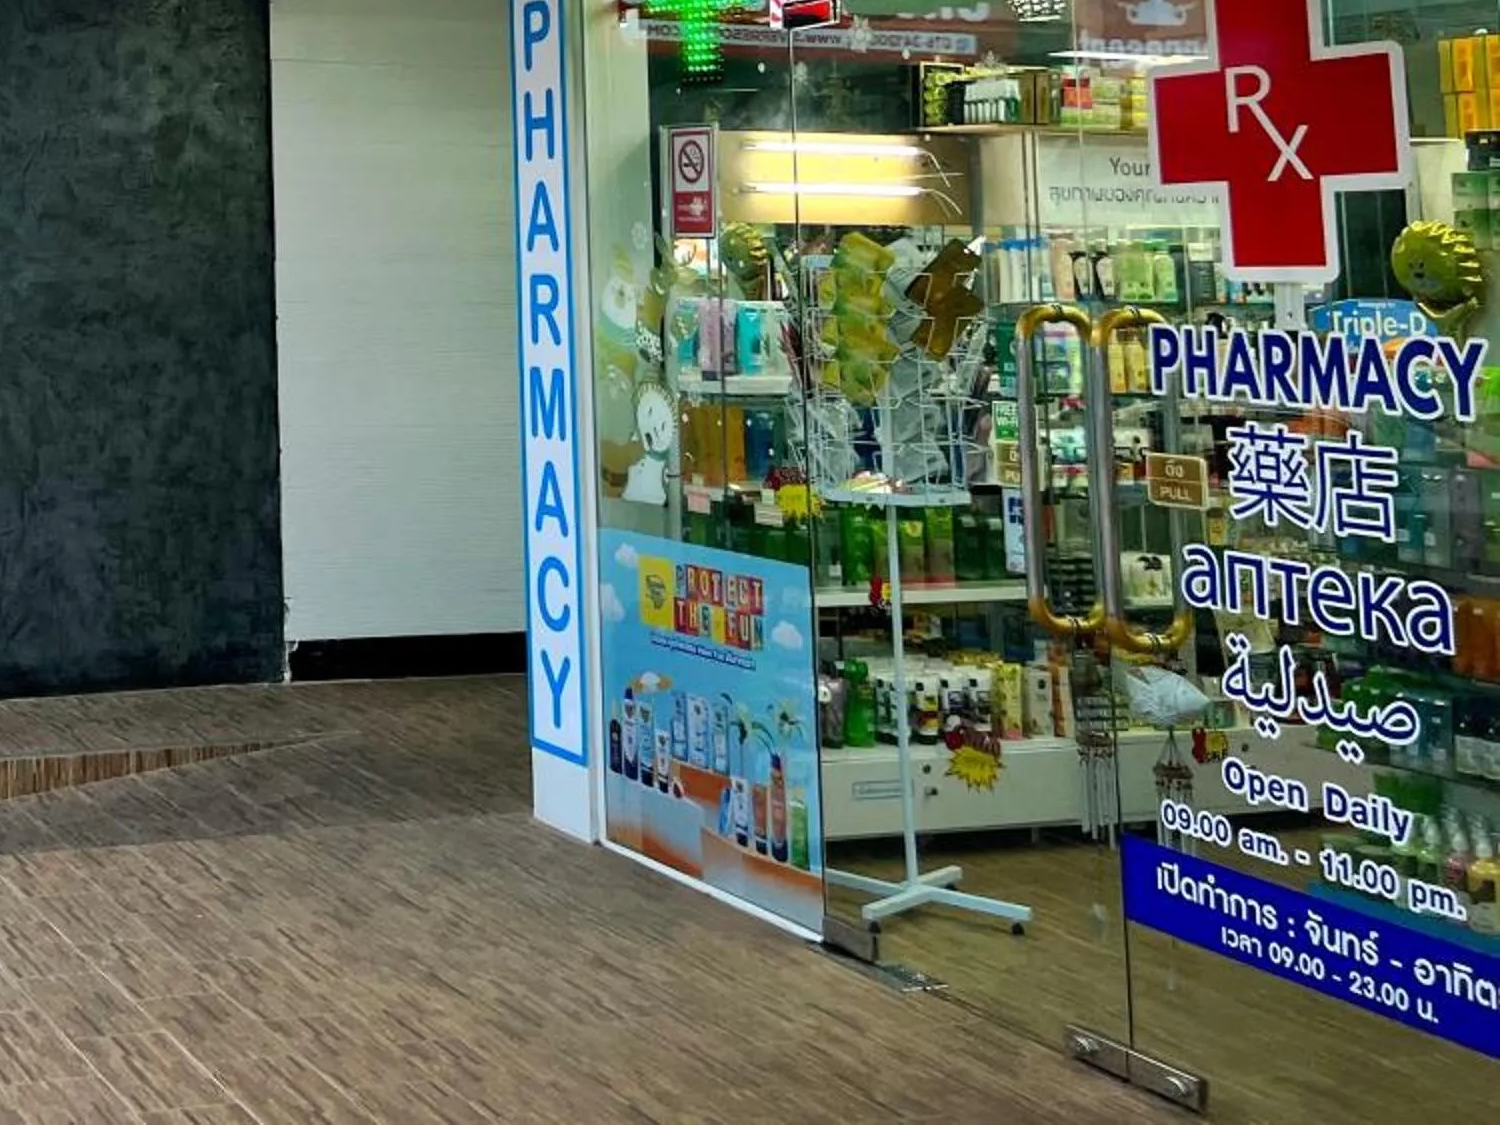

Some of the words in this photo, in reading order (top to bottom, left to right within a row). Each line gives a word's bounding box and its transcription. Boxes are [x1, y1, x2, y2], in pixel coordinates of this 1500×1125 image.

[1109, 156, 1150, 176] Your
[522, 0, 571, 729] PHARMACY
[1149, 325, 1487, 422] PHARMACY
[1331, 309, 1427, 337] Triple-D
[1159, 485, 1192, 501] PULL
[1227, 421, 1400, 543] 藥店
[1180, 543, 1456, 655] аптека
[1222, 633, 1420, 764] صيدلية
[1221, 757, 1308, 812] Open
[1323, 782, 1414, 845] Daily
[1161, 799, 1231, 848] 09.00
[1238, 827, 1290, 865] am.
[1320, 849, 1399, 899] 11.00
[1408, 878, 1468, 921] pm.
[1156, 862, 1278, 931] เปิดทำการ
[1304, 910, 1381, 967] จันทร์
[1413, 957, 1500, 1011] อาทิต
[1221, 926, 1263, 958] เวลา
[1269, 942, 1326, 981] 09.00
[1349, 971, 1410, 1012] 23.00
[1417, 996, 1439, 1024] น.
